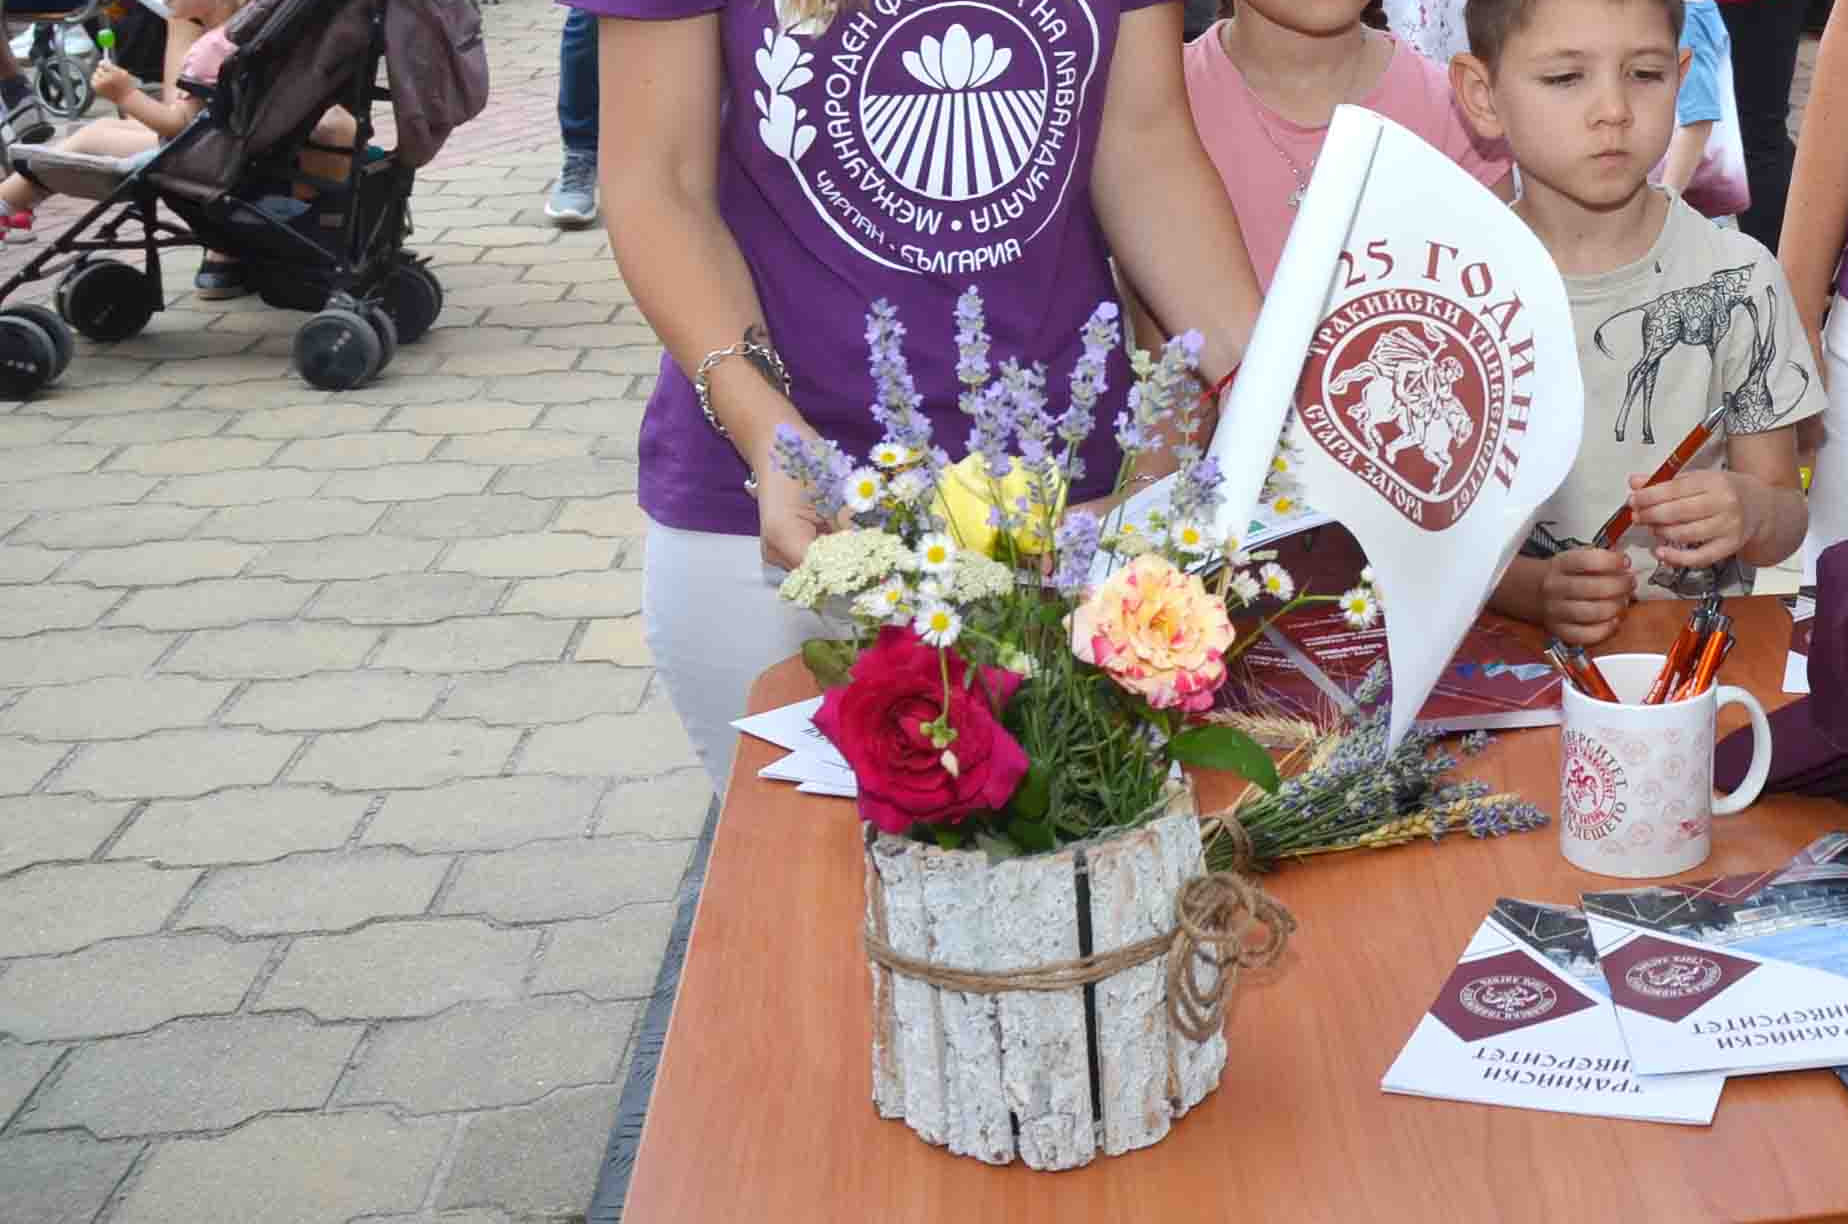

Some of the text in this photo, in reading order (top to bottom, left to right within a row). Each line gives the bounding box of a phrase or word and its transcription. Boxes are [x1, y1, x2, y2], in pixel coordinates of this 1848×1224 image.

[824, 10, 943, 235] МЕЖДУНАРОДЕН
[969, 48, 1077, 233] ЛАВАНДУЛАТА
[816, 169, 1022, 275] ЧИРПАН БЪЛГАРИЯ
[1308, 290, 1463, 358] ТРАКИЙСКИ
[1338, 239, 1536, 492] 25 ГОДИНИ
[1303, 403, 1424, 524] СТАРА ЗАГОРА
